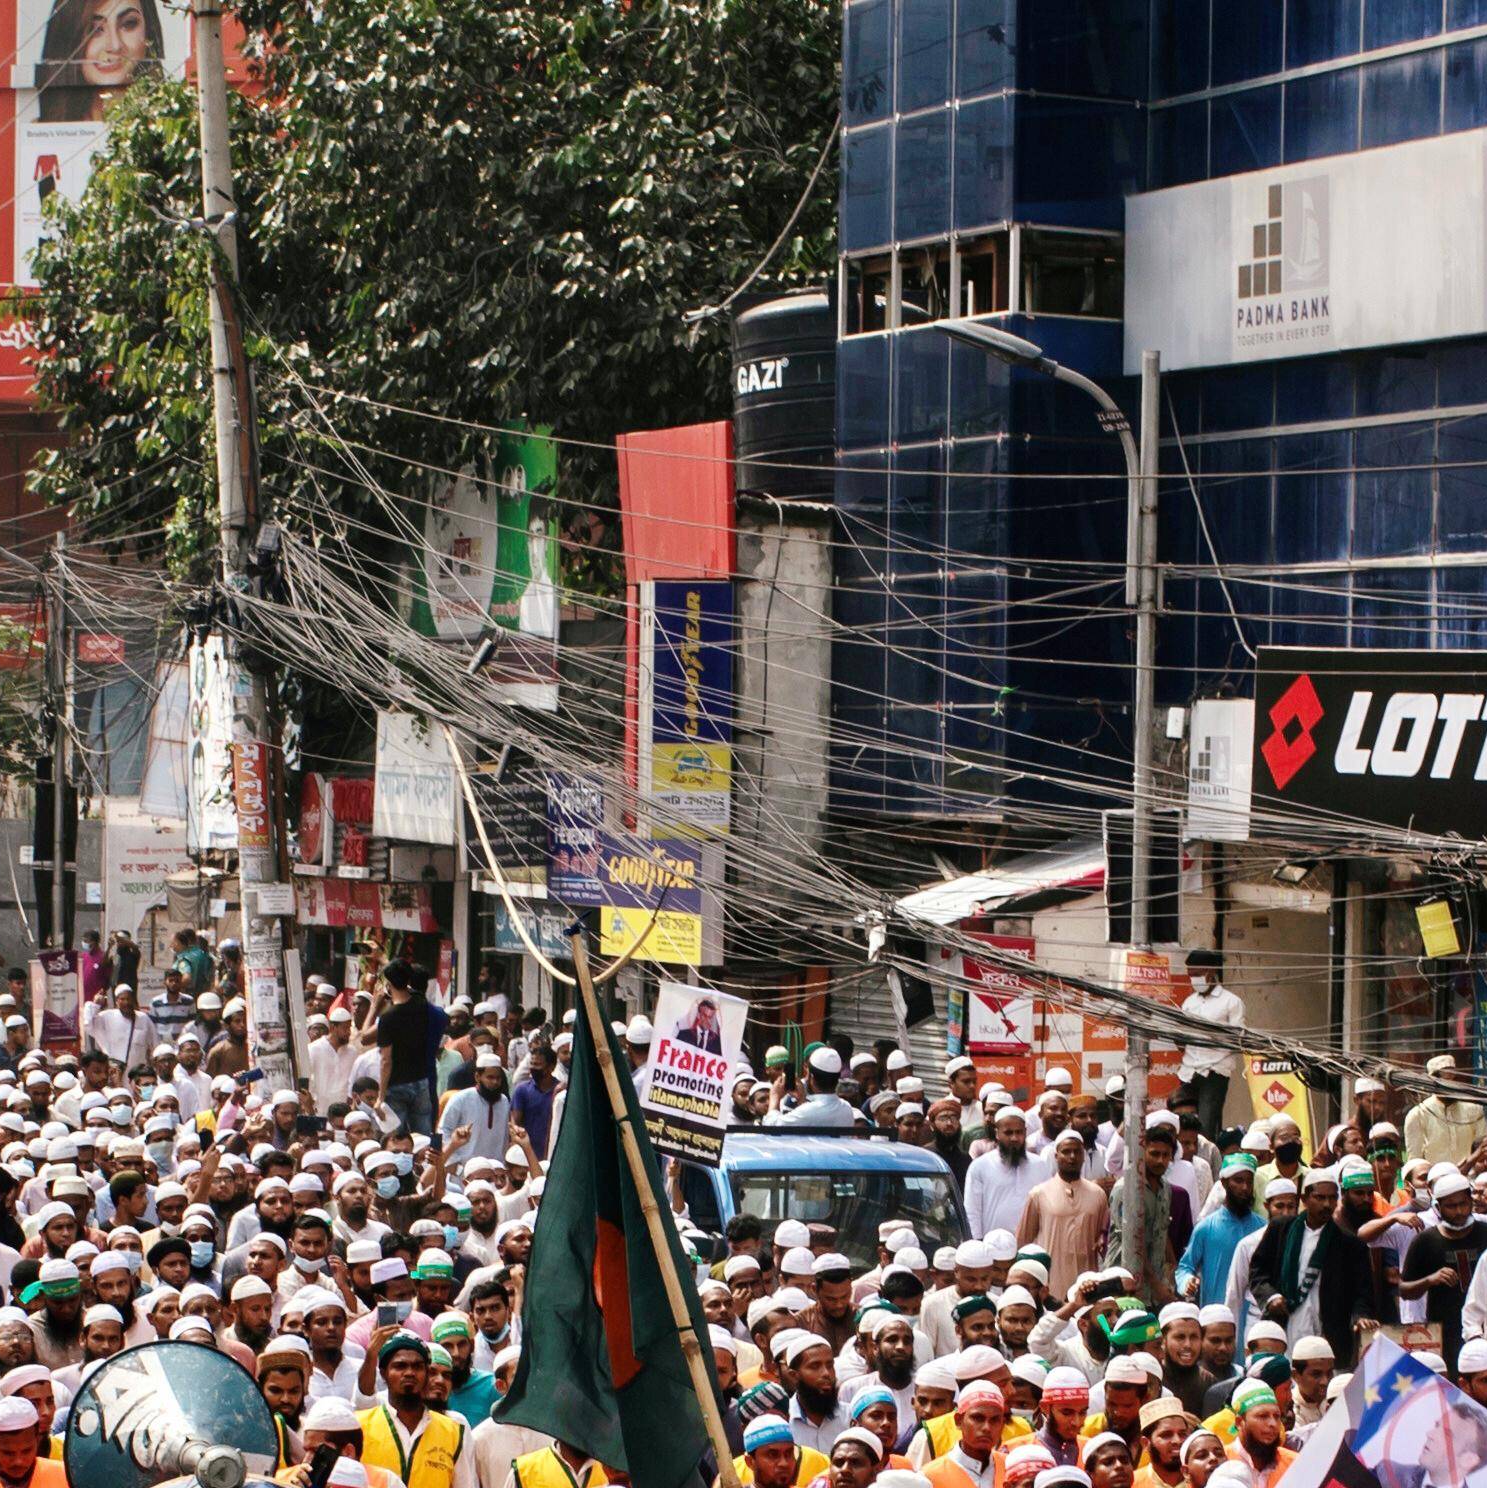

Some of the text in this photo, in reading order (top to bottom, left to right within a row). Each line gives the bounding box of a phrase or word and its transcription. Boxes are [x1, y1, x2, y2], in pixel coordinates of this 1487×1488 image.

[1238, 296, 1330, 328] PADMA BANK
[737, 360, 783, 394] GAZI
[680, 590, 706, 738] GOODYEAR
[608, 846, 696, 894] GOODYEAR
[657, 1037, 729, 1082] France
[652, 1068, 725, 1101] promoting
[649, 1085, 720, 1121] islamophobia
